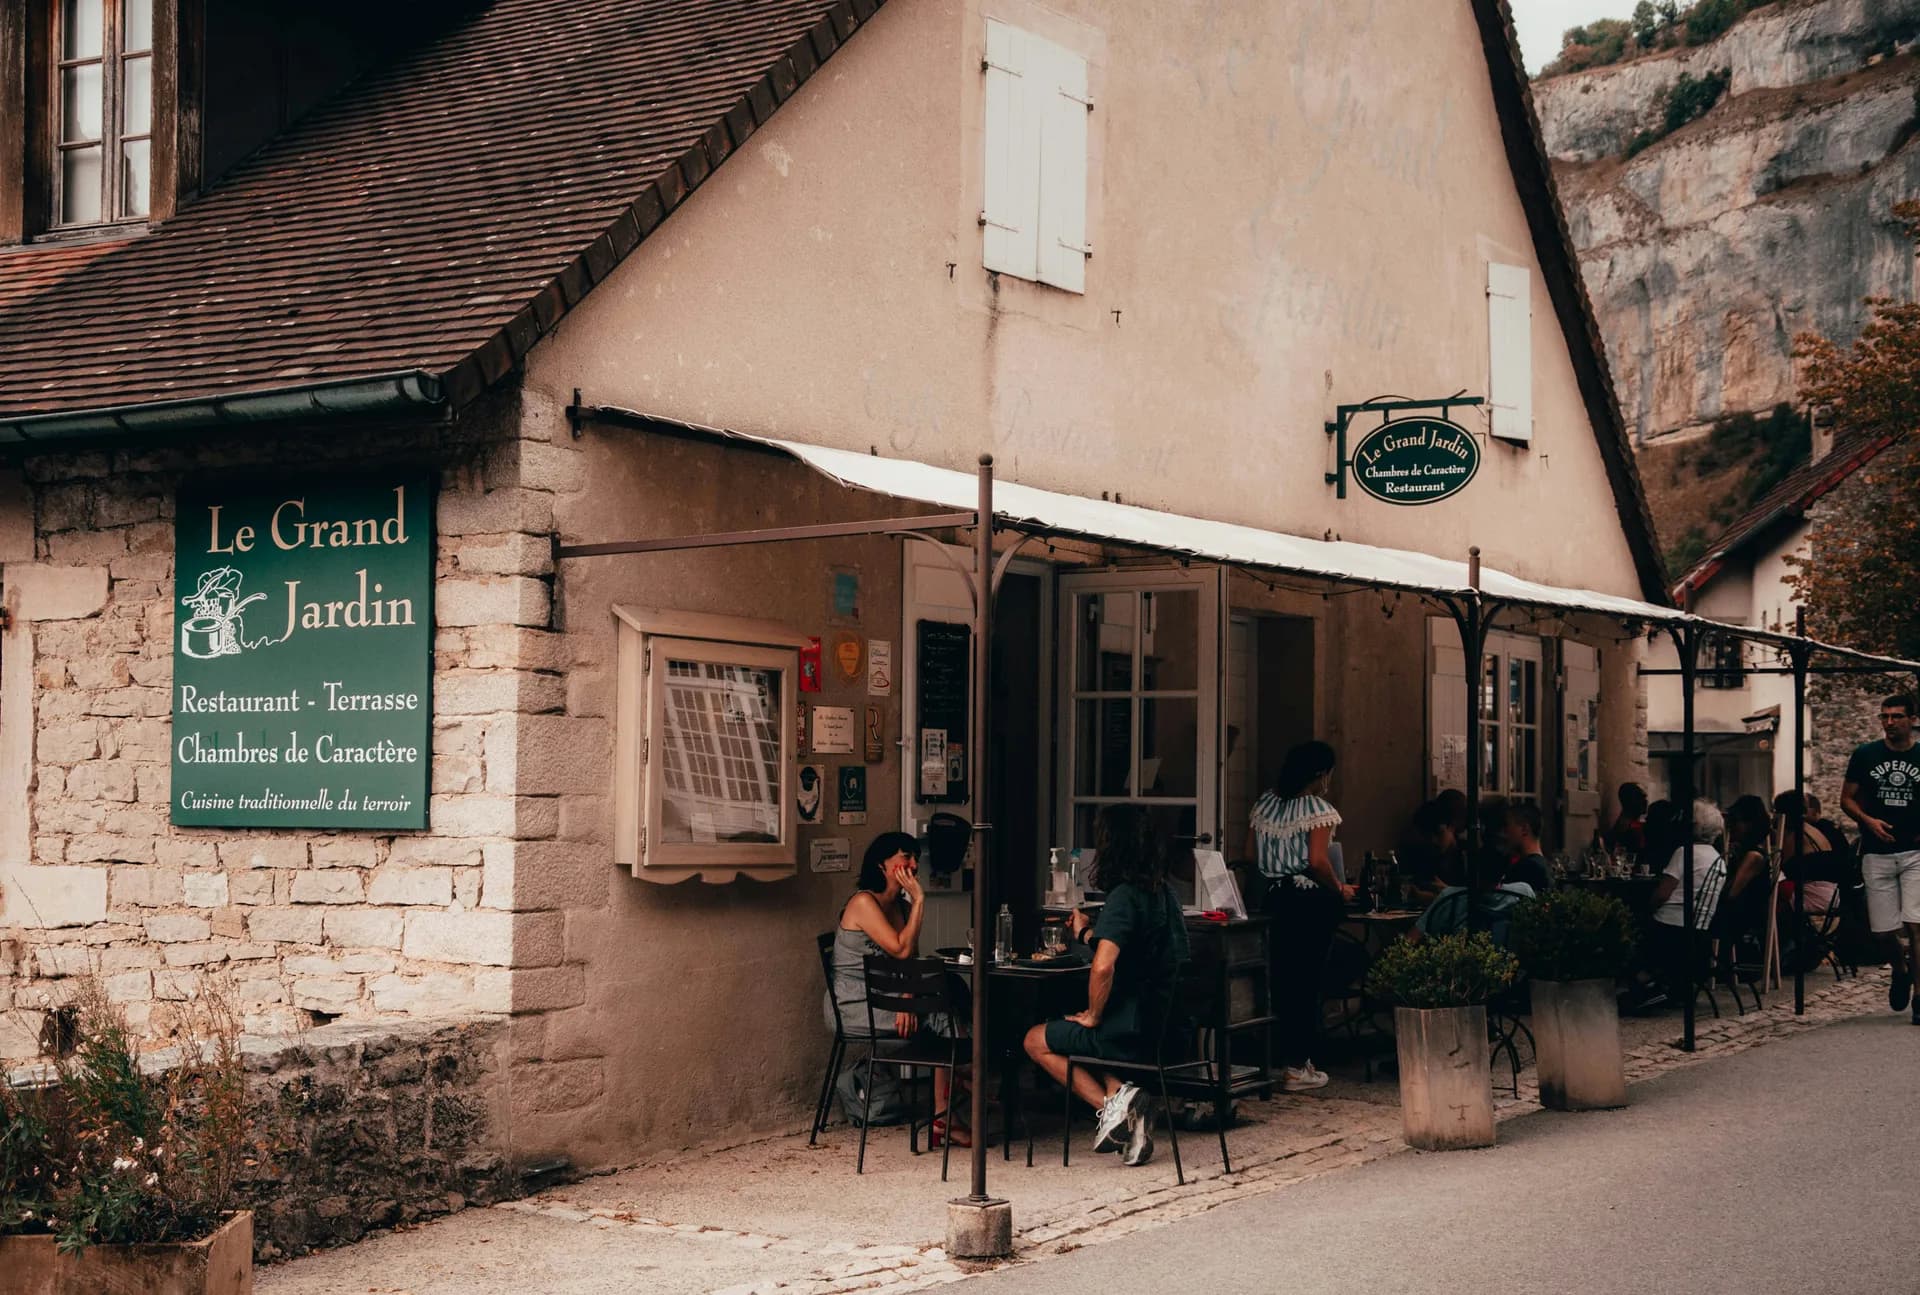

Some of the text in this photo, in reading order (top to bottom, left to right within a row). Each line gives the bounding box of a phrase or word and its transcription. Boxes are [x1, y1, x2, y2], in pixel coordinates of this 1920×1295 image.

[1362, 426, 1469, 464] Le Grand Jardin
[1365, 464, 1466, 478] Chambres de Caractère
[1386, 482, 1445, 493] Restaurant
[207, 486, 409, 555] Le Grand
[281, 569, 415, 641] Jardin
[180, 685, 300, 713] Restaurant
[324, 682, 418, 711] Terrasse
[178, 731, 417, 764] Chambres de Caractère
[181, 788, 411, 812] Cuisine traditionnelle du terroir
